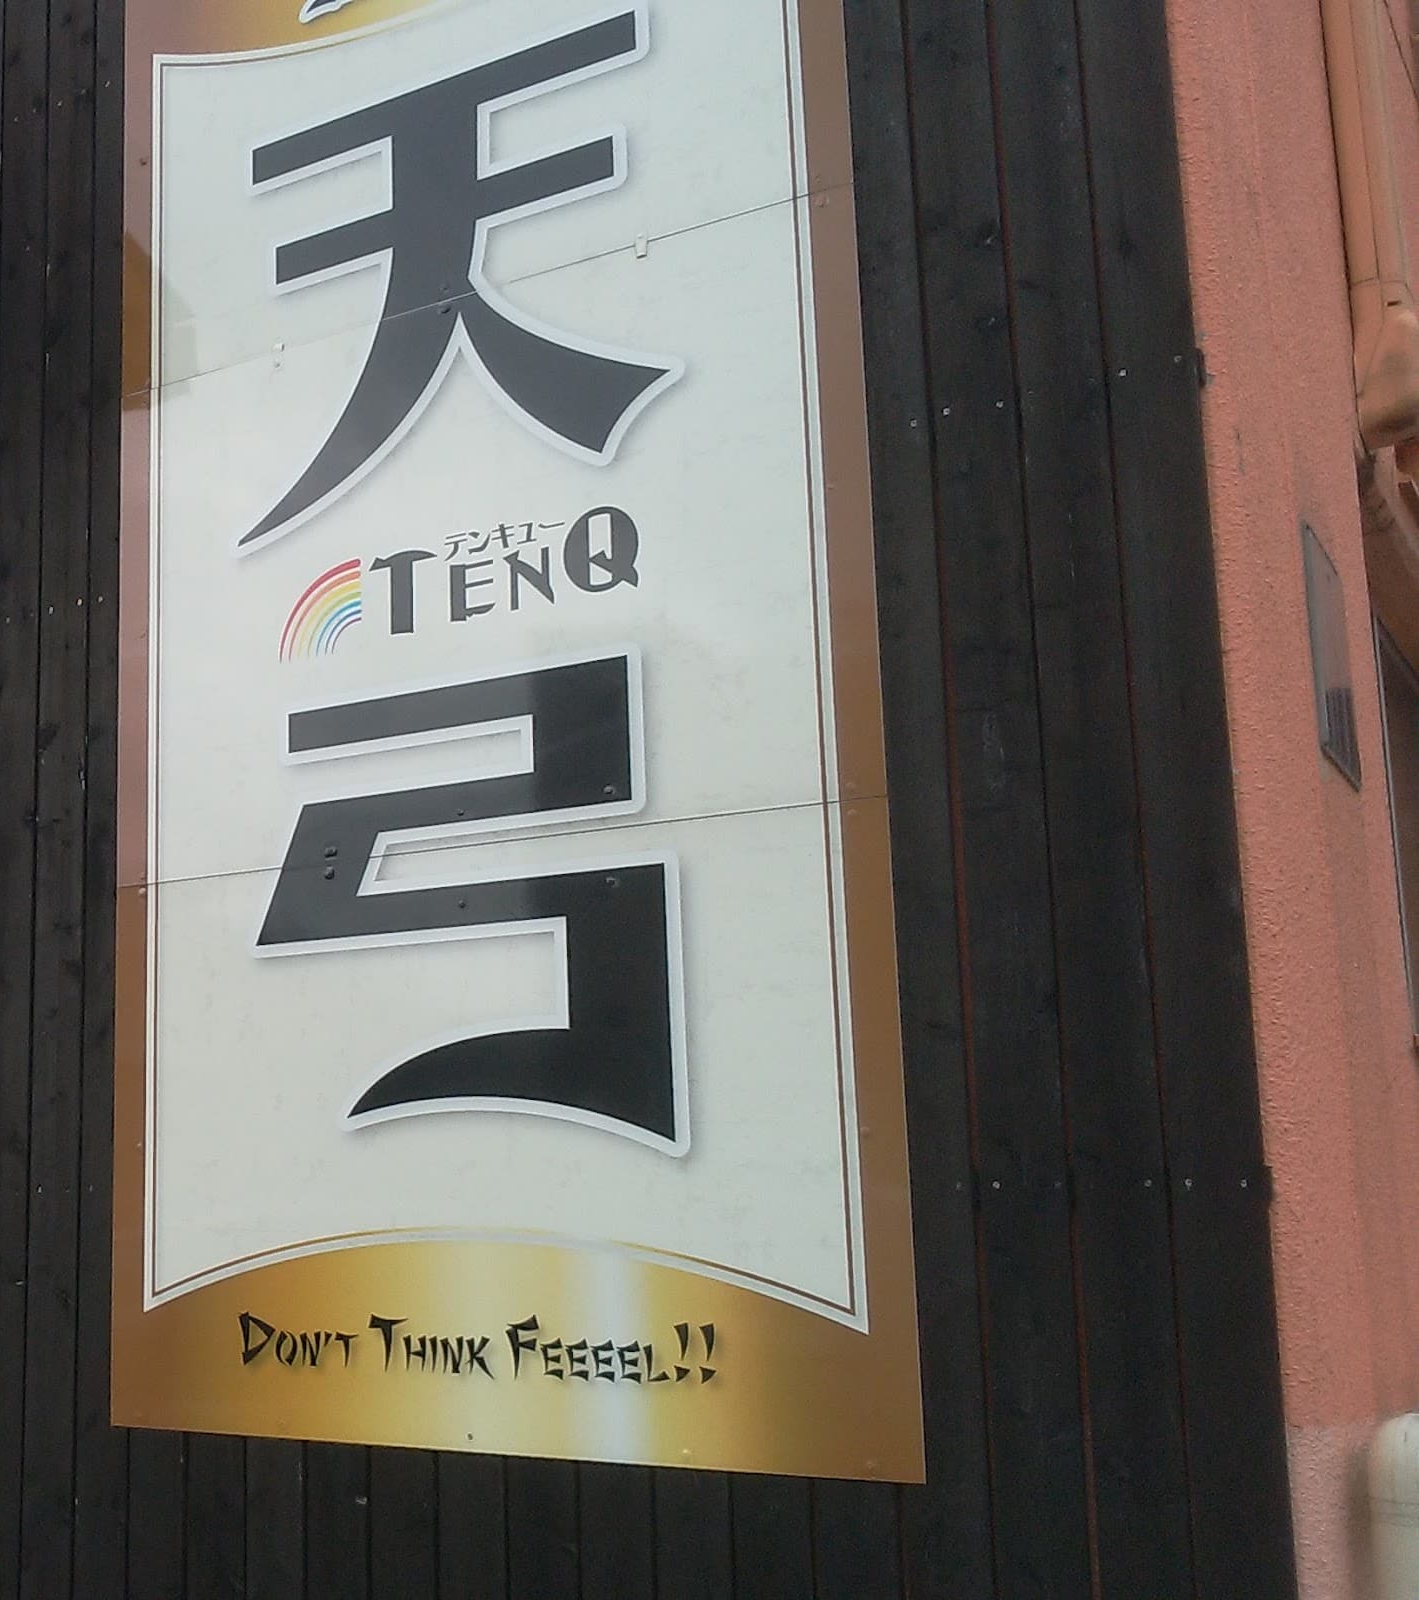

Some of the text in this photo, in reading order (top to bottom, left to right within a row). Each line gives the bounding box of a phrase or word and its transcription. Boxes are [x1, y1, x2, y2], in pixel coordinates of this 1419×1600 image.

[369, 505, 640, 635] TENQ
[444, 520, 566, 562] テンキュー
